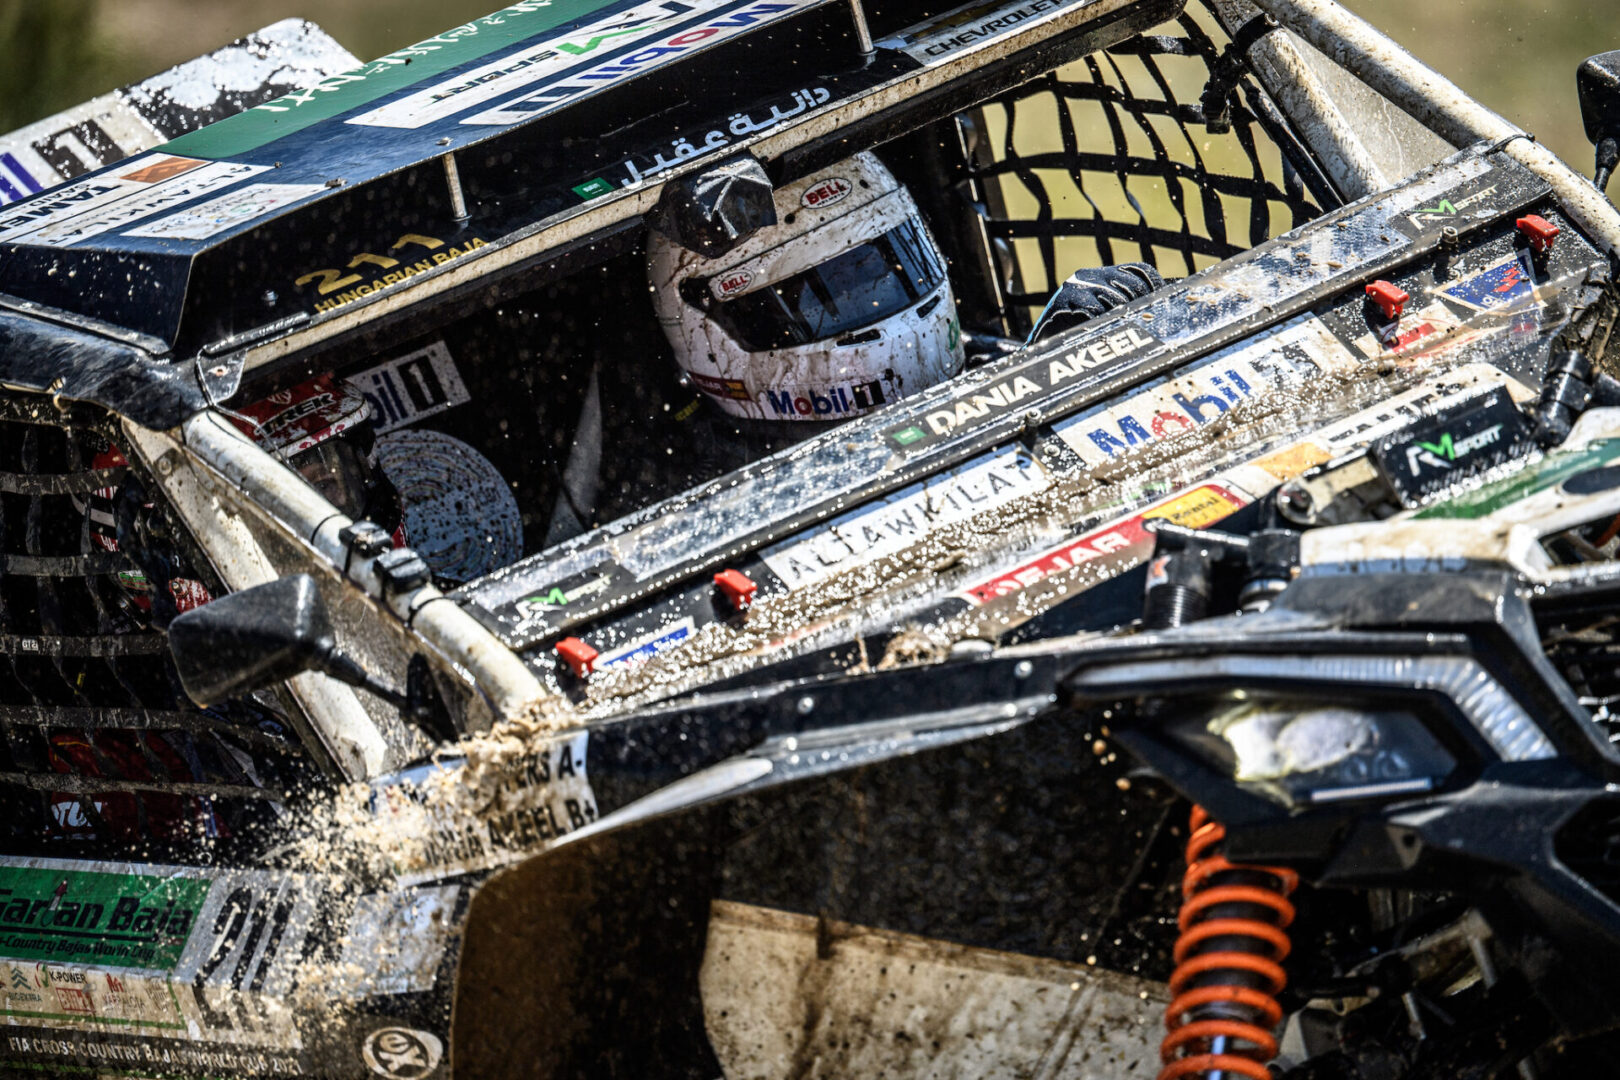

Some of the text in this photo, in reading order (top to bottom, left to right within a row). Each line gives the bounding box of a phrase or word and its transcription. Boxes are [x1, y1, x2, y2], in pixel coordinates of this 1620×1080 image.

[579, 3, 798, 81] Mobil
[430, 51, 558, 104] SPORT
[0, 183, 122, 233] TAME
[805, 181, 848, 205] BELL
[313, 237, 489, 315] HUNGARIAN BAJA
[721, 275, 748, 292] BELL
[767, 388, 849, 417] Mobil
[926, 326, 1156, 436] DANIA AKEEL
[1087, 369, 1252, 458] Mobil
[1453, 424, 1503, 459] SPORT
[105, 895, 194, 936] Baja
[8, 1036, 30, 1053] FIA
